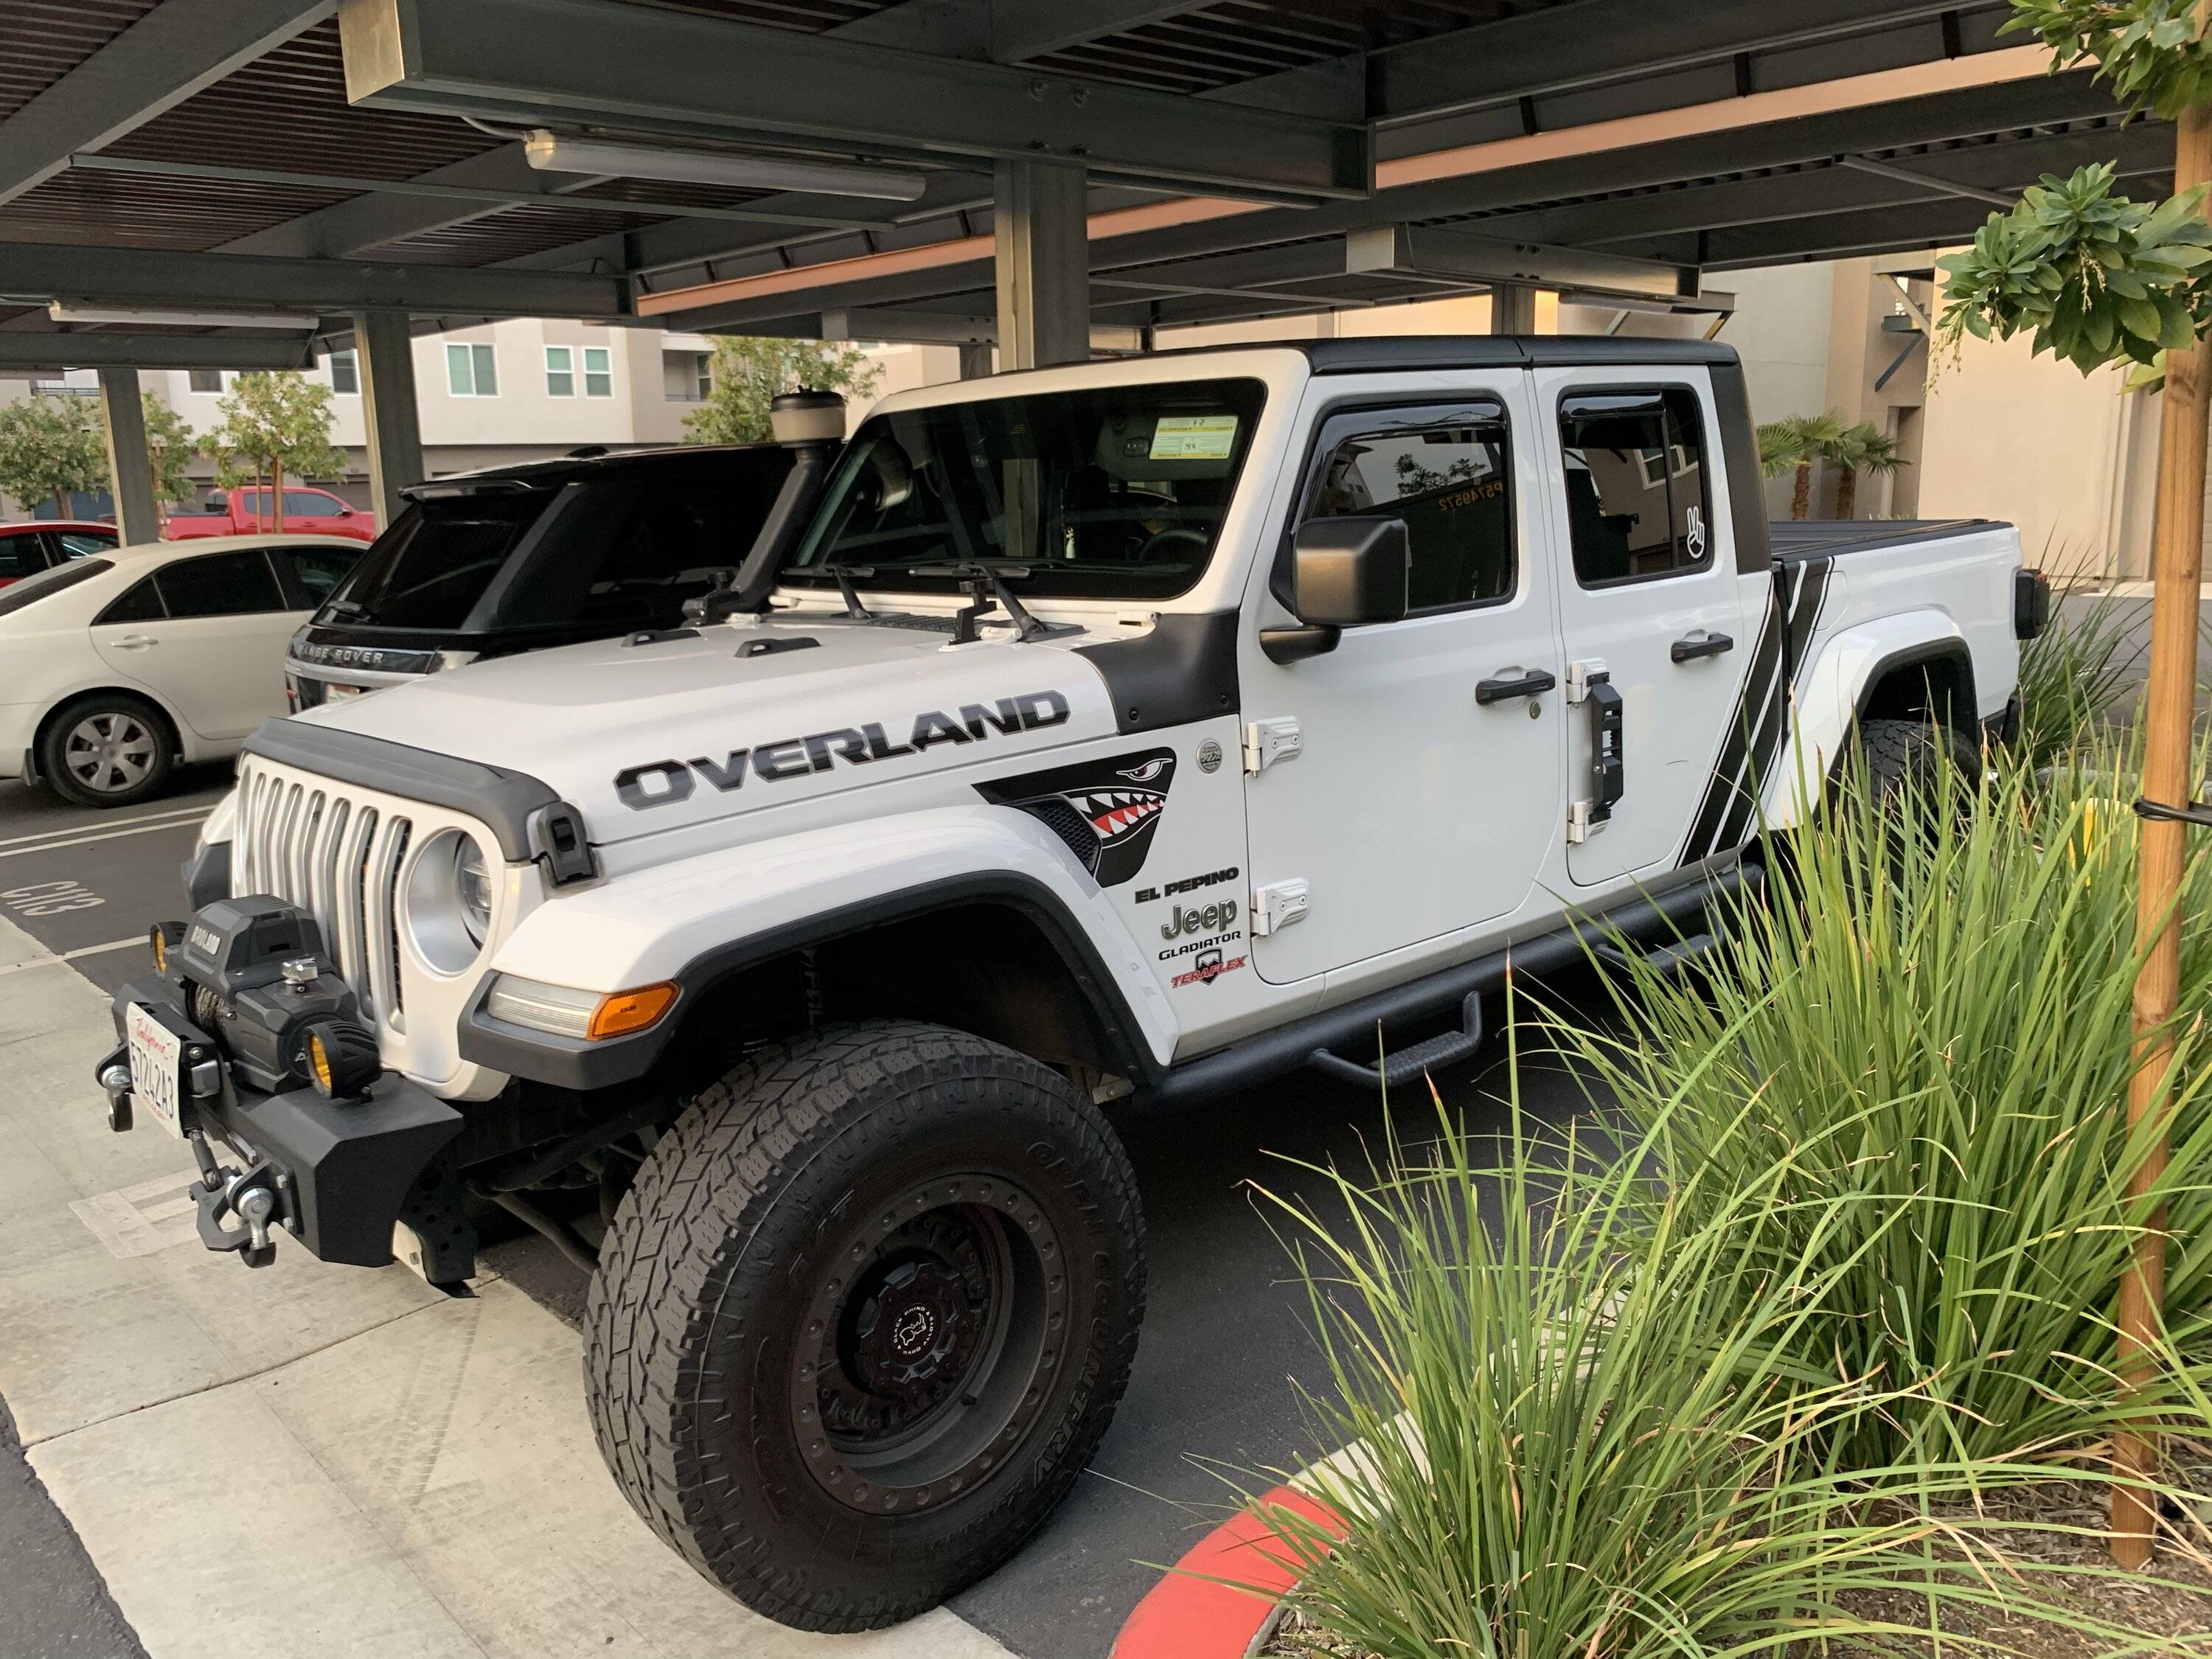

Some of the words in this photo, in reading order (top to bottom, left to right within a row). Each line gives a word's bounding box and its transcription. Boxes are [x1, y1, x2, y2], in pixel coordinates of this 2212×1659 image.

[299, 644, 330, 658] RANGE
[335, 649, 383, 664] ROVER
[613, 689, 1071, 810] OVERLAND
[1135, 887, 1161, 904] EL
[1164, 866, 1239, 897] PEPINO
[1161, 899, 1237, 940] Jeep
[1158, 931, 1242, 961] GLADIATOR
[1171, 955, 1248, 989] TERAFLEX
